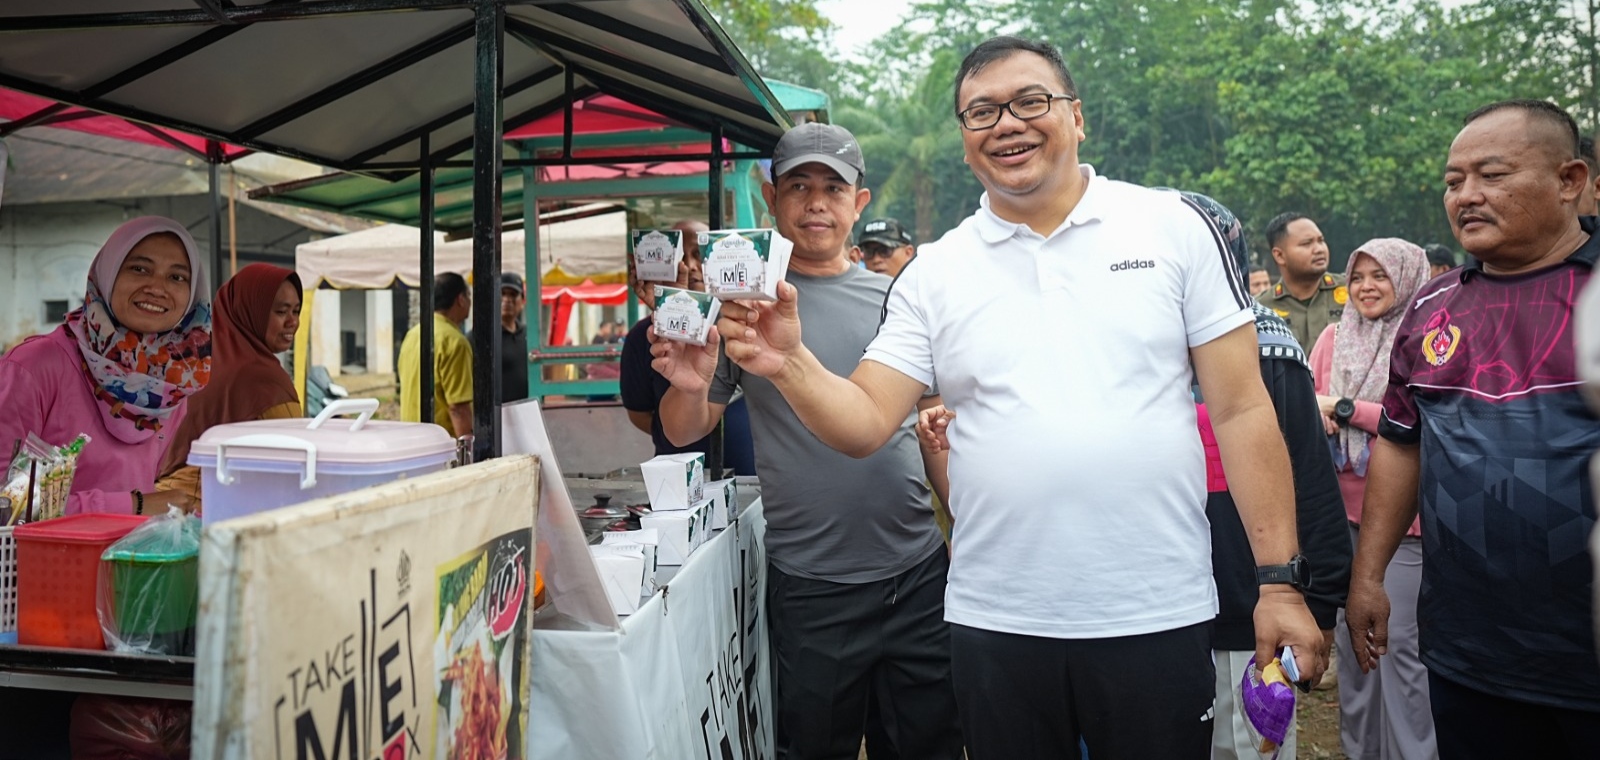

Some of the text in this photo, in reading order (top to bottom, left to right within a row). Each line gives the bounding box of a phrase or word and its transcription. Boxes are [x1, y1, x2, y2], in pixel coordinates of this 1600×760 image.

[1110, 259, 1155, 271] adidas
[724, 271, 744, 282] ME
[670, 320, 687, 331] ME
[287, 633, 354, 710] TAKE
[706, 632, 741, 731] TAKE
